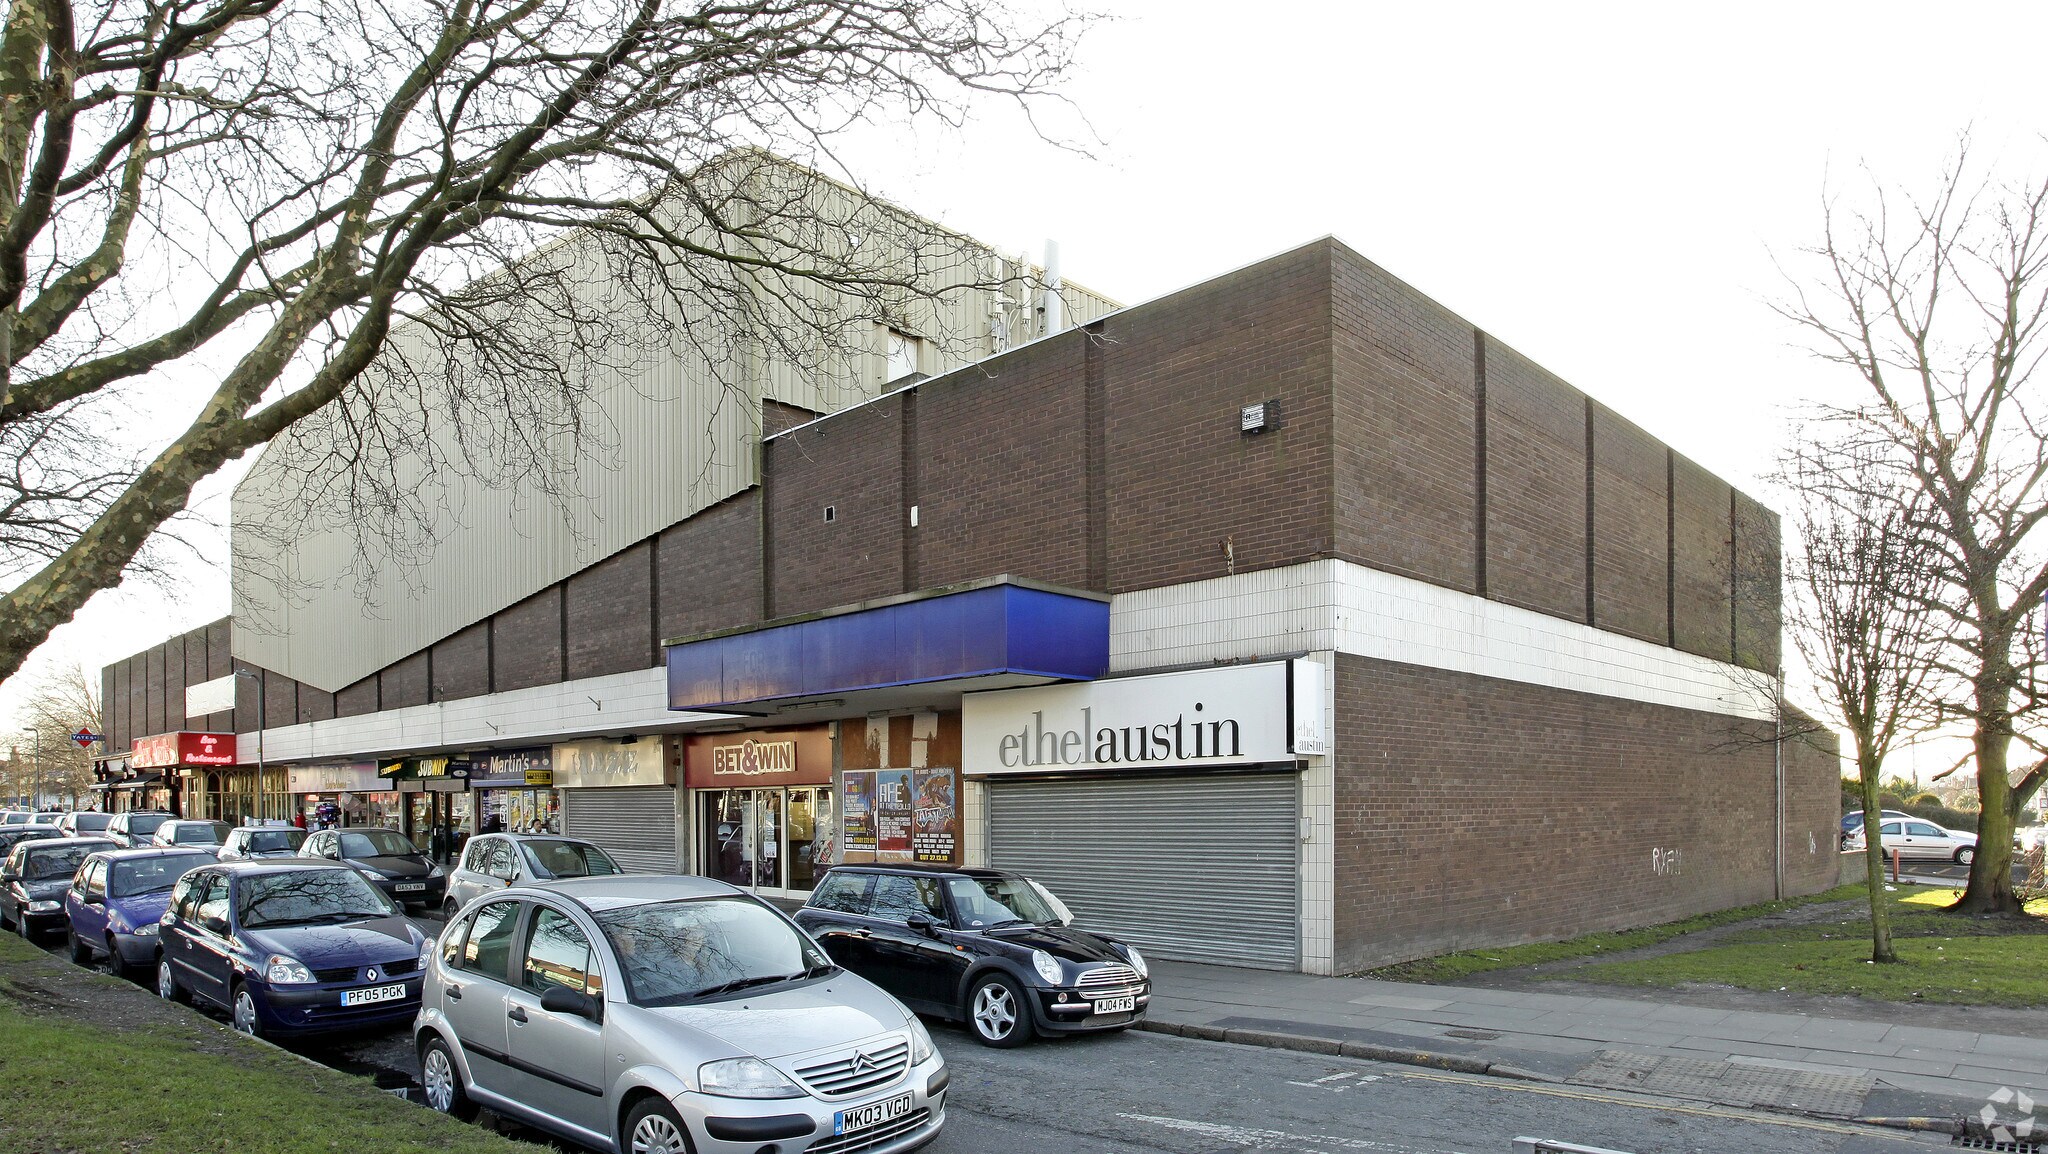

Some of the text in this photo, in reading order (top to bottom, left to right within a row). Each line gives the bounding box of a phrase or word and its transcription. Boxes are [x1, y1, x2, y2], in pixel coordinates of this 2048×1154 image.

[1296, 720, 1315, 738] ethel
[200, 735, 218, 744] Bar
[1298, 736, 1324, 752] austin
[185, 753, 233, 764] Restaurant
[417, 757, 448, 777] SUBWAY
[489, 753, 530, 774] Martin's
[379, 761, 404, 776] SUBWAY
[348, 985, 403, 1003] PF05 PGK
[845, 1096, 910, 1130] MK03 VGD
